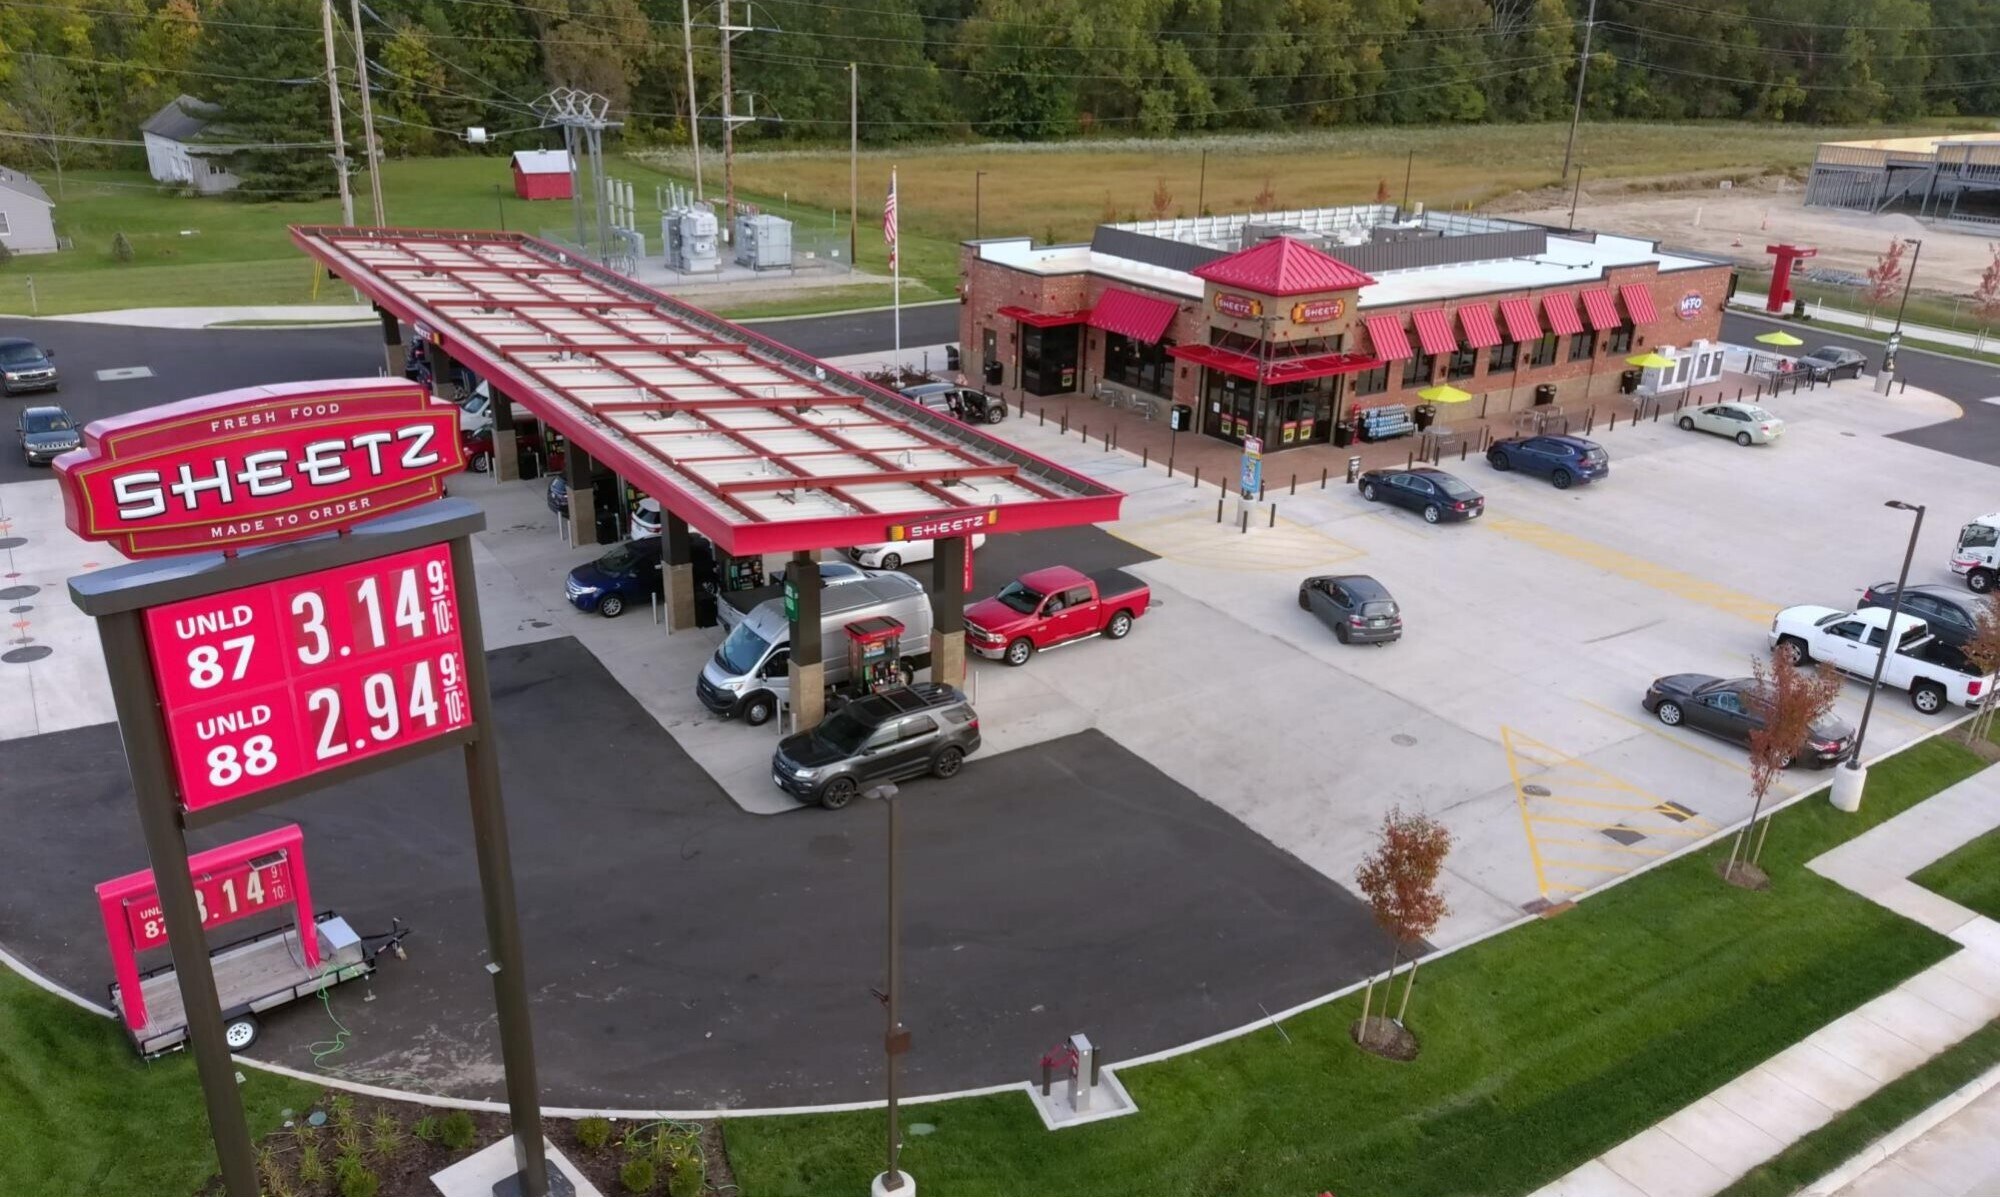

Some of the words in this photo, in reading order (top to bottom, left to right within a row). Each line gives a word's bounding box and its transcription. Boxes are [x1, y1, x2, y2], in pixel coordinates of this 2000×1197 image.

[211, 411, 277, 432] FRESH
[290, 402, 341, 419] FOOD
[113, 423, 440, 520] SHEETZ
[211, 520, 265, 539] MADE
[275, 513, 300, 528] TO
[309, 496, 372, 521] ORDER
[911, 515, 984, 537] SHEETZ
[176, 604, 254, 640] UNLD
[290, 568, 426, 666] 3.14
[187, 634, 256, 689] 87
[196, 704, 271, 740] UNLD
[308, 660, 440, 760] 2.94
[205, 734, 278, 788] 88
[140, 905, 163, 920] UNL
